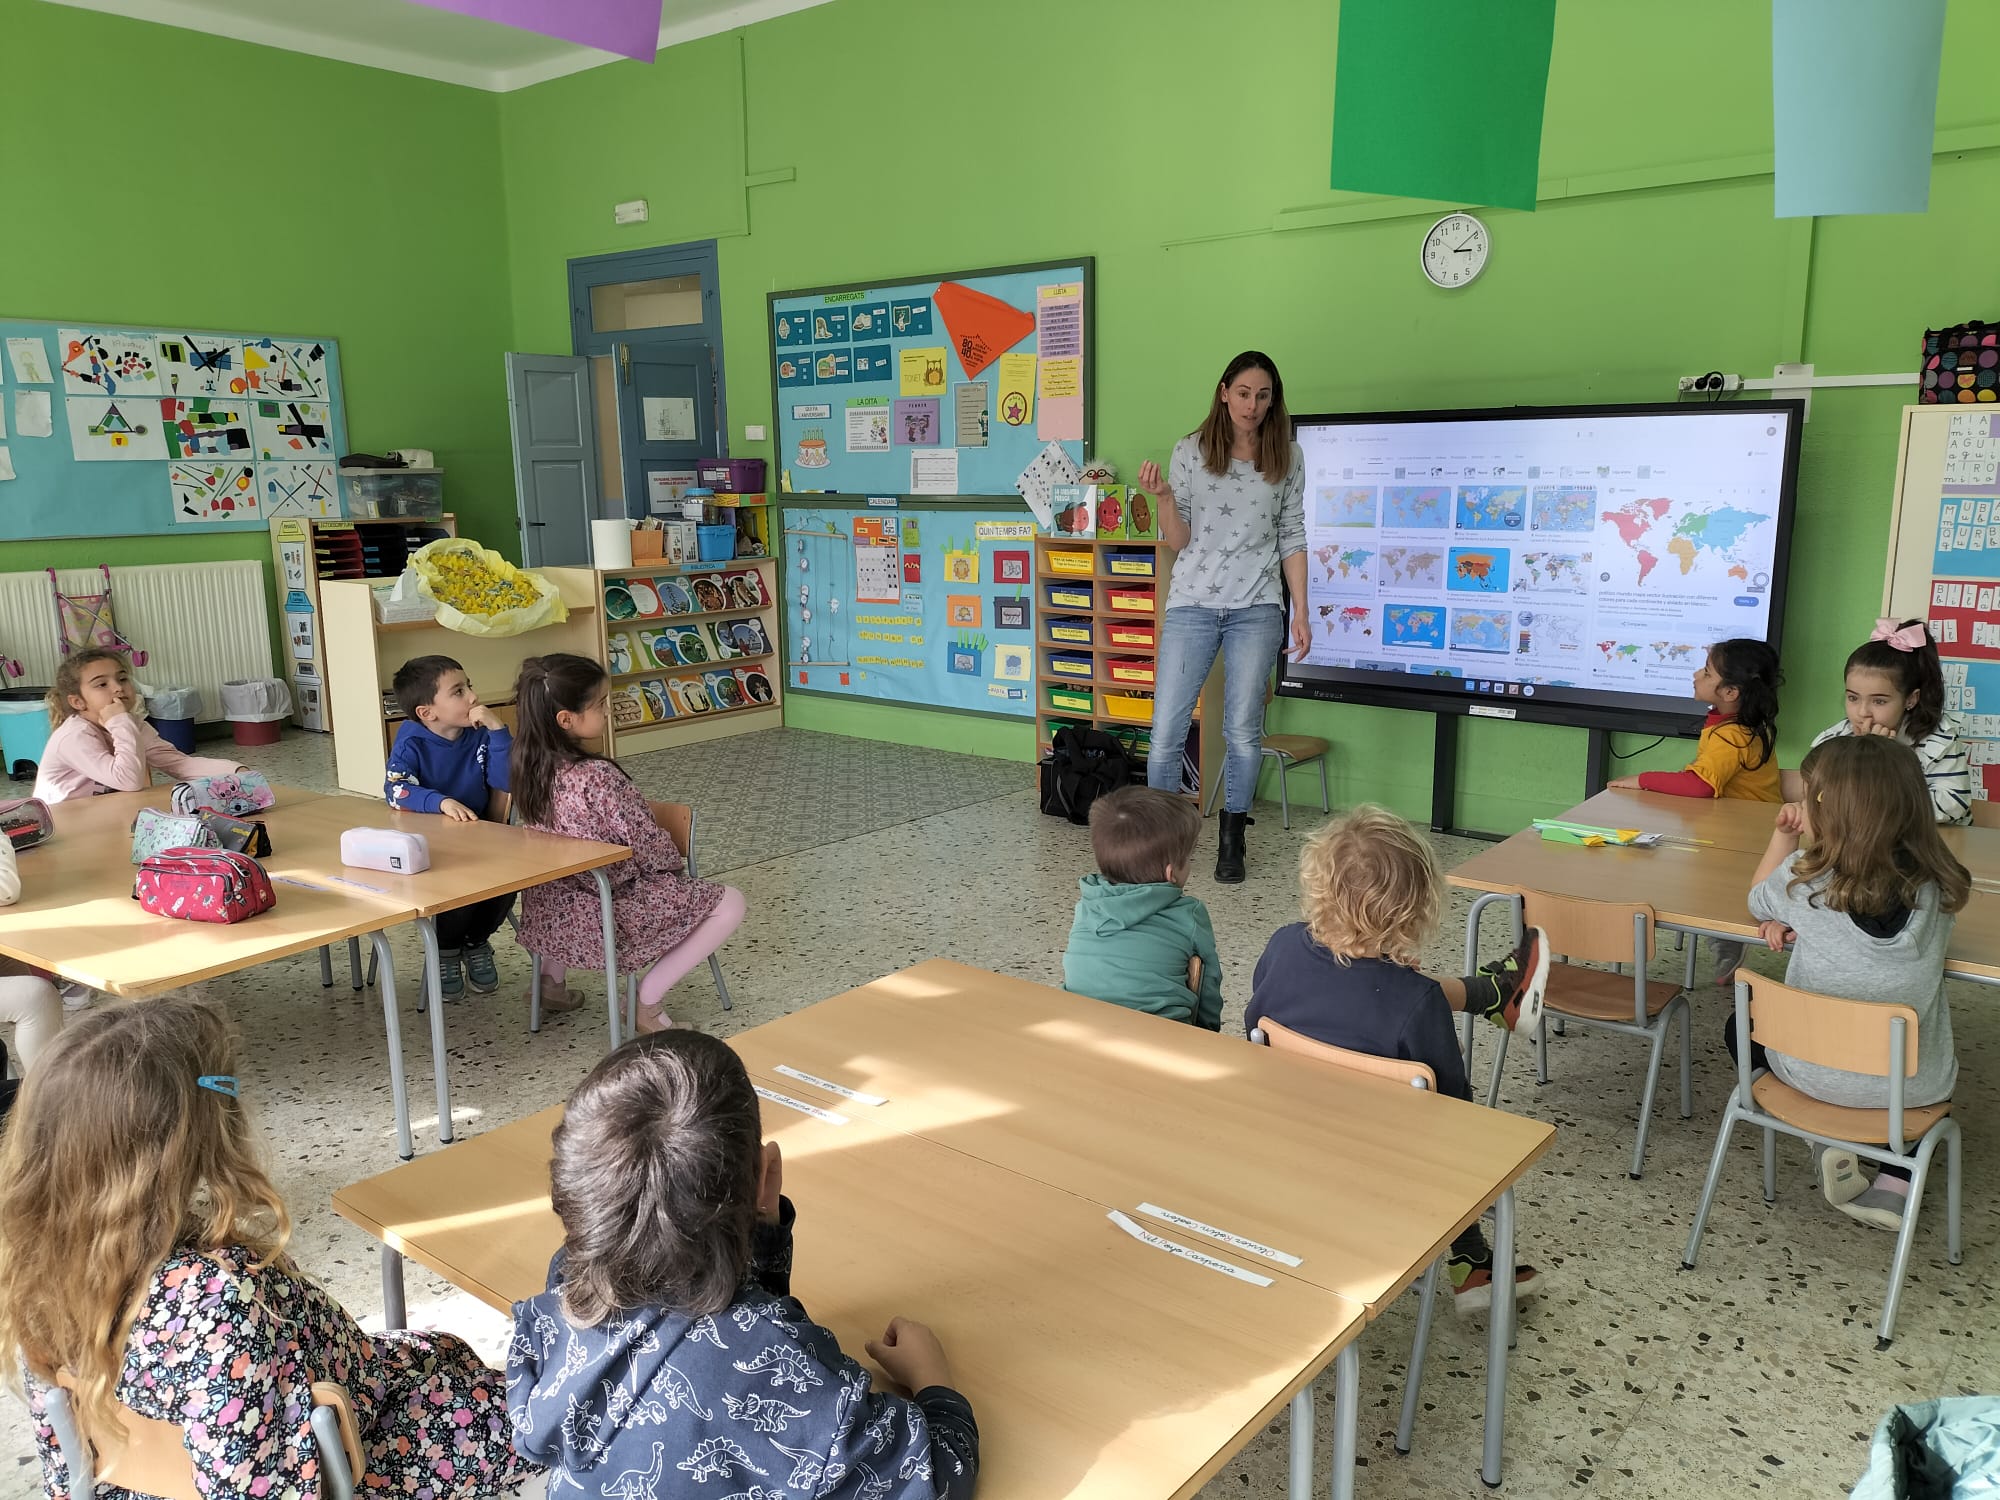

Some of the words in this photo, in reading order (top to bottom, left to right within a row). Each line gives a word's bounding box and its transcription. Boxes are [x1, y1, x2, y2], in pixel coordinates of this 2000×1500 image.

[1452, 222, 1460, 231] 12
[1466, 224, 1470, 232] 1
[1441, 228, 1448, 236] 11
[1474, 231, 1479, 240] 2
[1432, 238, 1441, 247] 10
[1477, 244, 1482, 252] 3
[1442, 271, 1447, 279] 7
[1453, 273, 1459, 281] 6
[824, 292, 865, 303] ENCARREGATS
[856, 398, 864, 406] LA
[1953, 415, 1987, 425] MIA
[1946, 462, 1995, 472] MIRO
[979, 527, 994, 536] QUIN
[996, 527, 1017, 536] TEMPS
[1019, 526, 1031, 535] FA?
[1138, 1231, 1157, 1246] Nil
